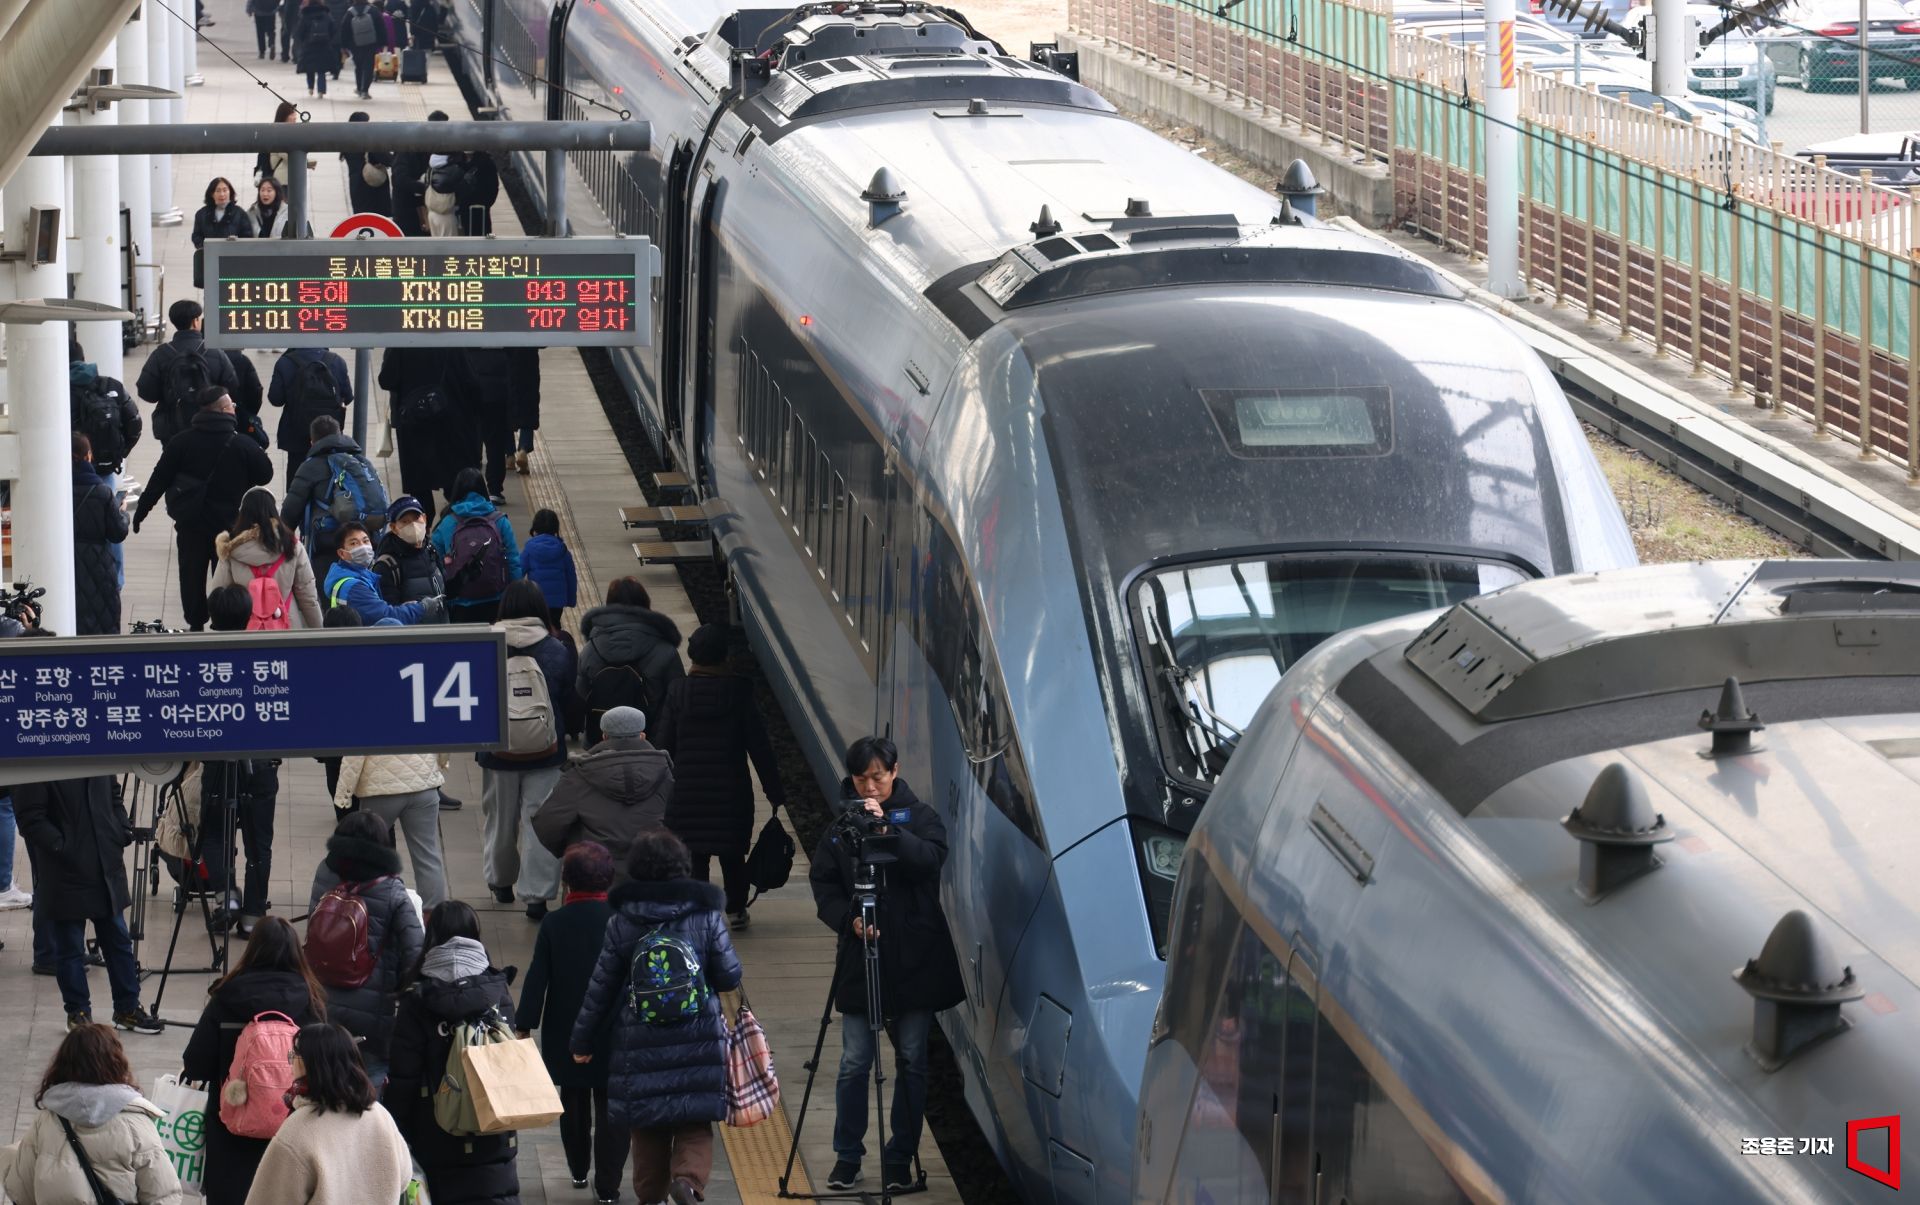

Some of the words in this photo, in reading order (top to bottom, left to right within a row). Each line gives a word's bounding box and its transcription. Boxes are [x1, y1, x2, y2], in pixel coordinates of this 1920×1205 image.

[329, 257, 426, 279] 동시출발!
[443, 257, 541, 278] 호차확인!
[228, 282, 291, 302] 11:01
[298, 281, 348, 304] 동해
[401, 281, 440, 302] KTX
[447, 281, 485, 302] 이음
[527, 280, 566, 301] 843
[577, 280, 629, 303] 열차
[228, 310, 291, 330] 11:01
[298, 308, 348, 331] 안동
[401, 309, 440, 329] KTX
[447, 309, 485, 330] 이음
[527, 308, 566, 329] 707
[577, 308, 629, 331] 열차
[35, 667, 72, 688] 포항
[90, 665, 125, 686] 진주
[144, 664, 181, 684] 마산
[198, 662, 234, 683] 강릉
[252, 660, 289, 681] 동해
[35, 692, 73, 703] Pohang
[92, 690, 117, 702] Jinju
[146, 688, 180, 698] Masan
[198, 686, 243, 698] Gangneung
[253, 684, 290, 697] Donghae
[399, 661, 479, 723] 14
[17, 707, 88, 729] 광주송정
[107, 705, 141, 726] 목포
[160, 702, 246, 724] 여수EXPO
[255, 701, 290, 722] 방면
[16, 733, 50, 745] Gwangju
[51, 732, 91, 744] songjeong
[107, 730, 142, 742] Mokpo
[163, 728, 195, 739] Yeosu
[196, 727, 223, 739] Expo
